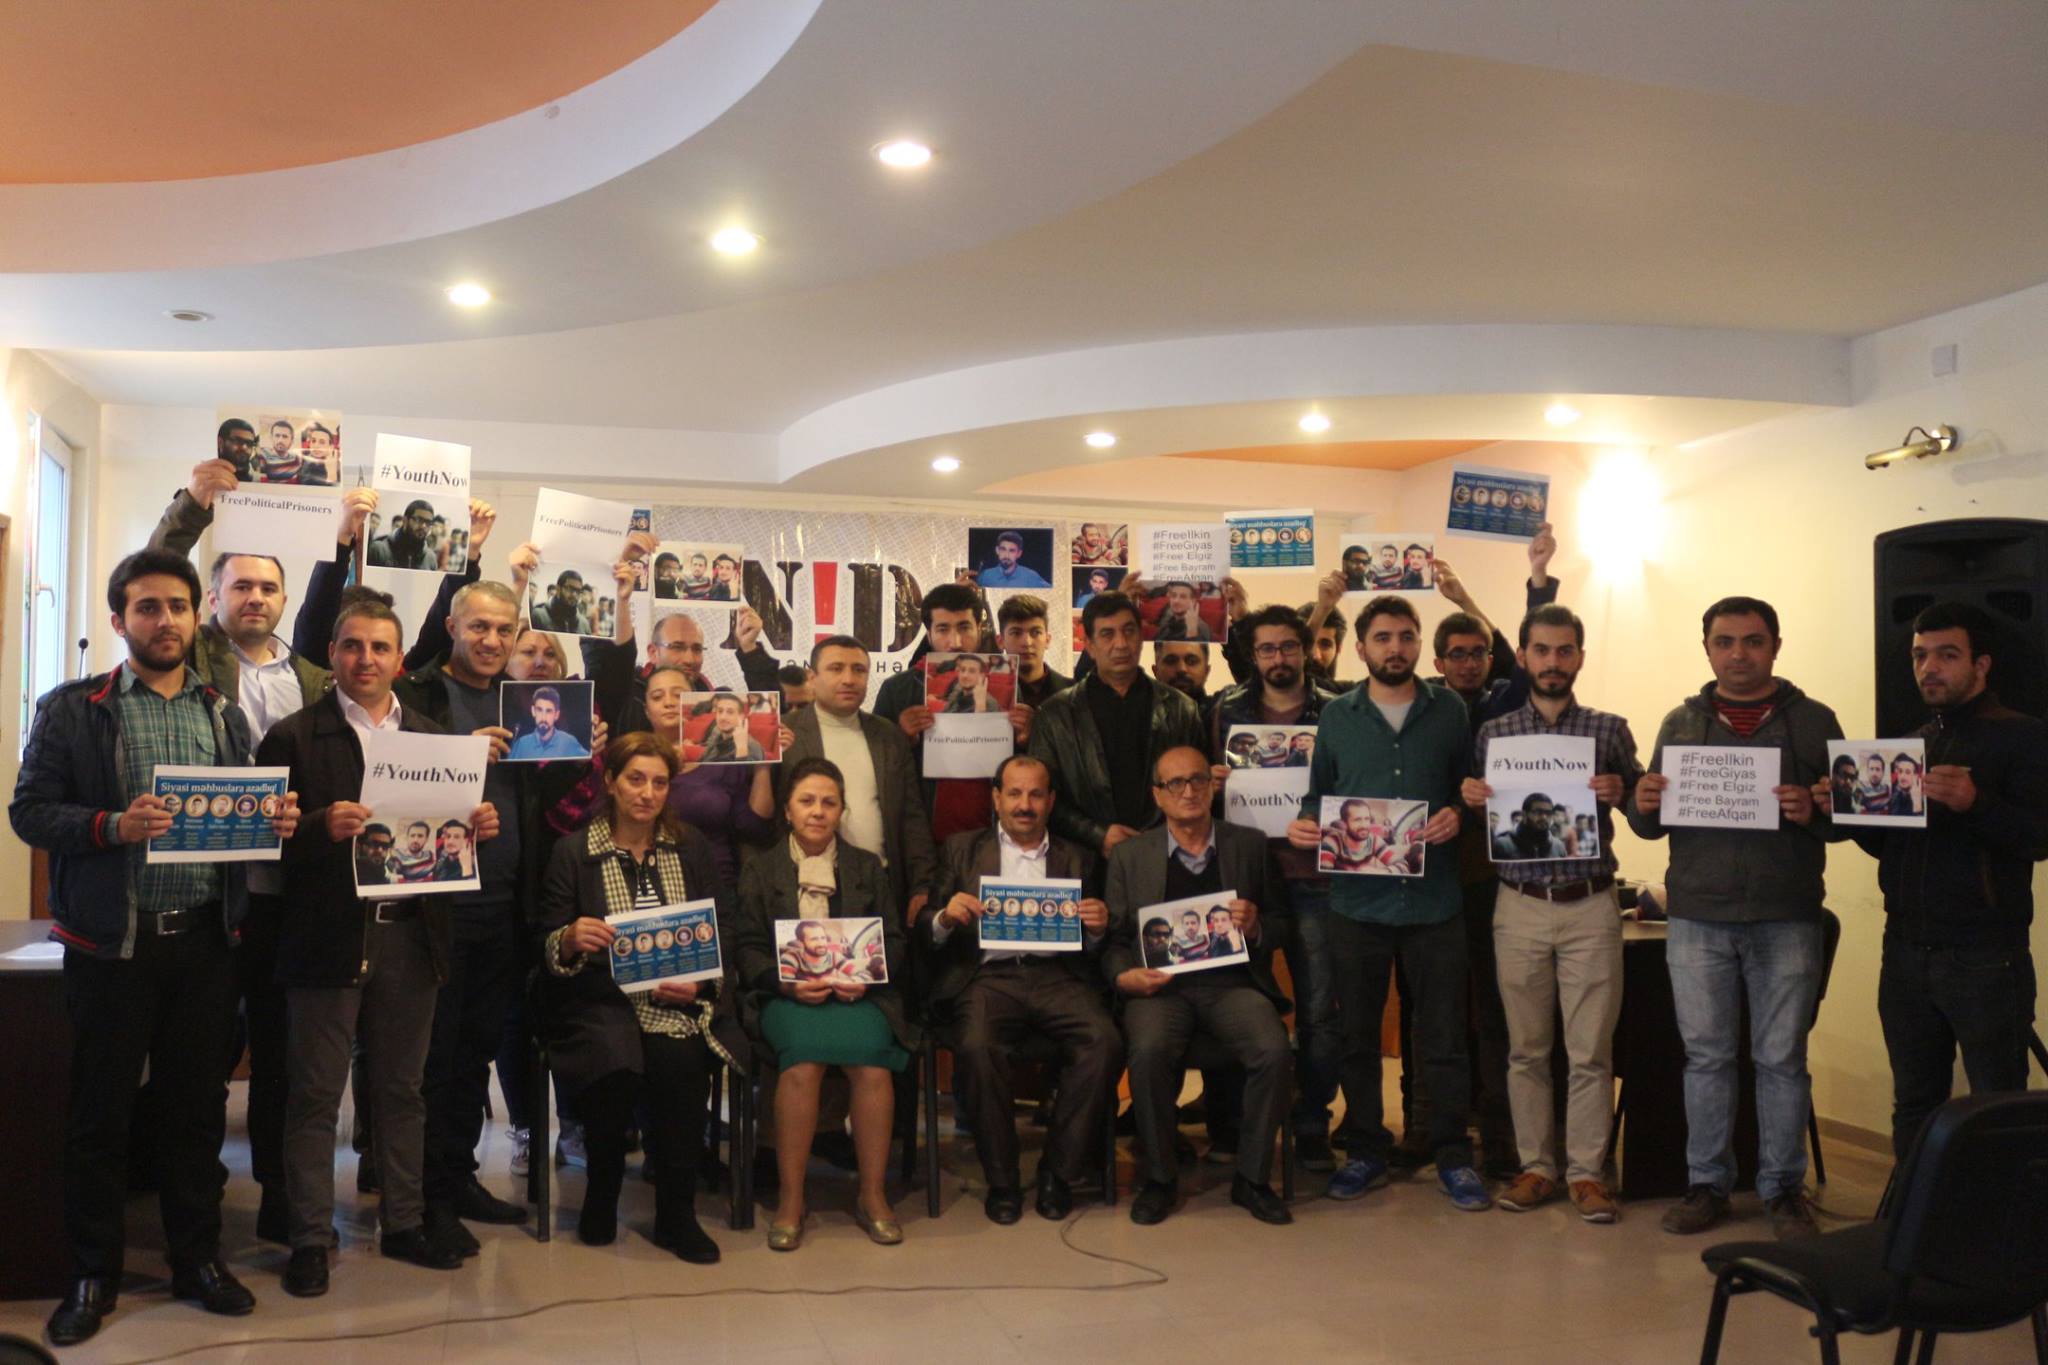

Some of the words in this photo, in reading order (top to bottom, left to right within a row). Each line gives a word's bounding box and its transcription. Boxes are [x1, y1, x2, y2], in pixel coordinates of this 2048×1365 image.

[1152, 552, 1184, 561] #Free
[1152, 563, 1179, 572] #Free
[1181, 563, 1216, 573] Bayram
[1493, 757, 1589, 771] #YouthNow
[372, 761, 481, 784] #YouthNow
[1680, 766, 1757, 780] #FreeGiyas
[160, 782, 190, 793] Siyasi
[1680, 780, 1718, 790] #Free
[1723, 781, 1757, 794] Elgiz
[1230, 791, 1302, 808] #YouthNo
[1679, 794, 1712, 805] #Free
[1715, 794, 1760, 808] Bayram
[1678, 806, 1756, 822] #FreeAfqan
